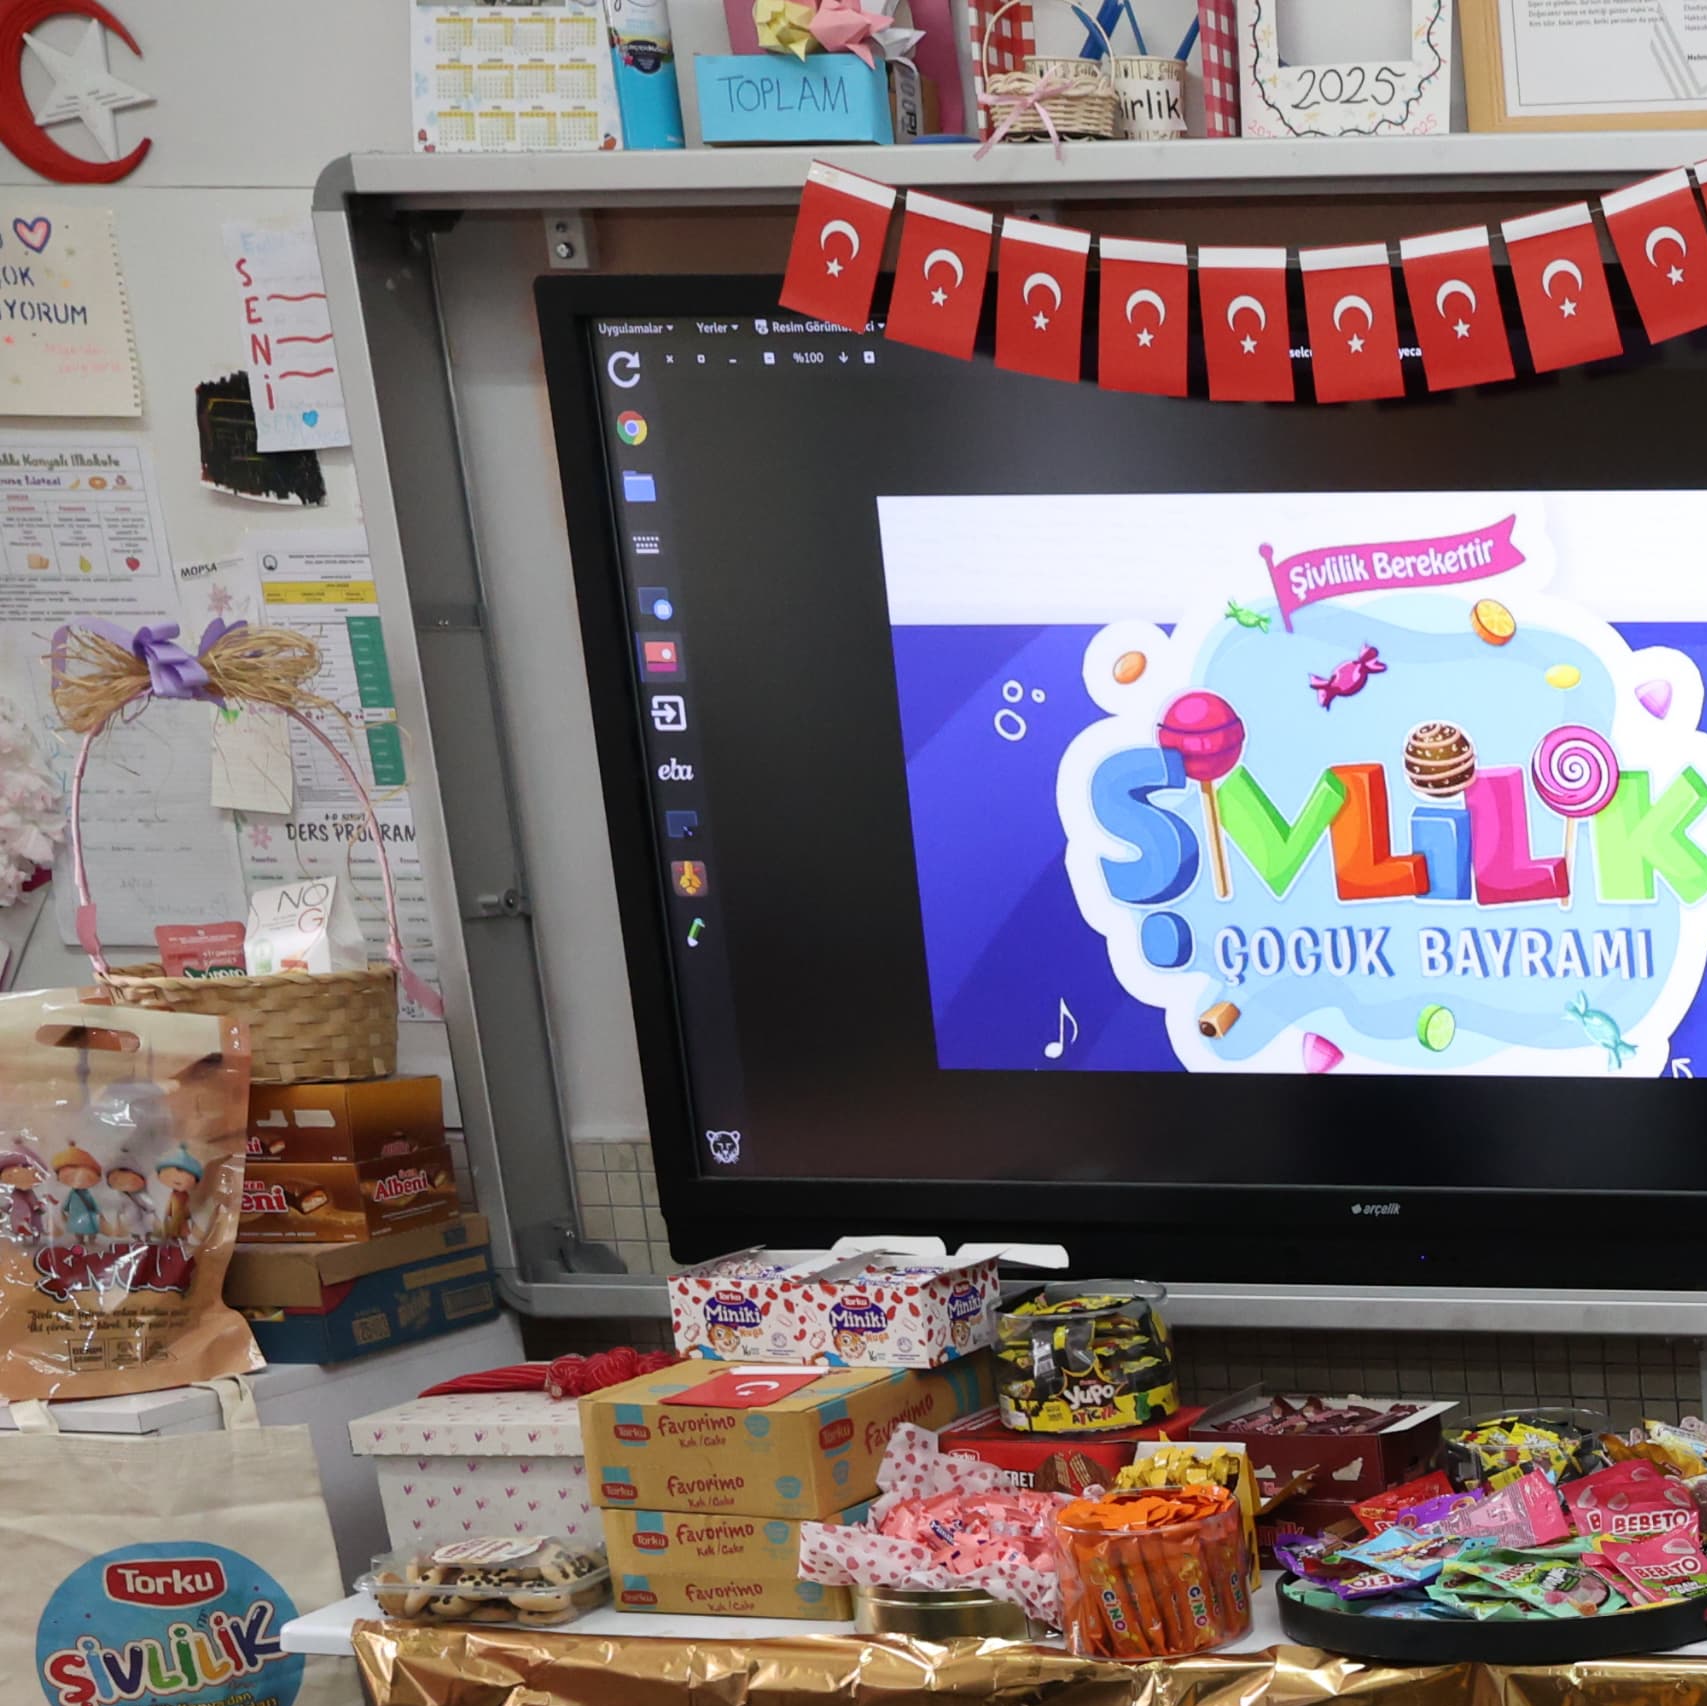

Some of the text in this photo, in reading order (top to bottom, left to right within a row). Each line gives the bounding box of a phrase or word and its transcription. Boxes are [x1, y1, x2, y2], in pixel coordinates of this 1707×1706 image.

[718, 75, 850, 115] TOPLAM
[1291, 66, 1406, 110] 2025
[0, 300, 88, 325] YORUM
[598, 322, 663, 336] Uygulamalar
[696, 322, 728, 333] Yerler
[772, 321, 804, 333] Resim
[792, 353, 824, 364] %100
[1288, 536, 1496, 602] Şivlilik Berekettir
[285, 823, 329, 842] DERS
[1214, 925, 1656, 988] ÇOCUK BAYRAMI
[1362, 1202, 1401, 1217] arçelik
[704, 1304, 762, 1325] Miniki
[830, 1309, 887, 1330] Miniki
[658, 1413, 736, 1437] favorimo
[667, 1474, 744, 1497] favorimo
[1613, 1510, 1689, 1533] BEBETO
[636, 1522, 755, 1547] Torku favorimo
[1636, 1558, 1700, 1580] BEBETO
[117, 1567, 215, 1595] Torku
[685, 1582, 763, 1603] favorimo
